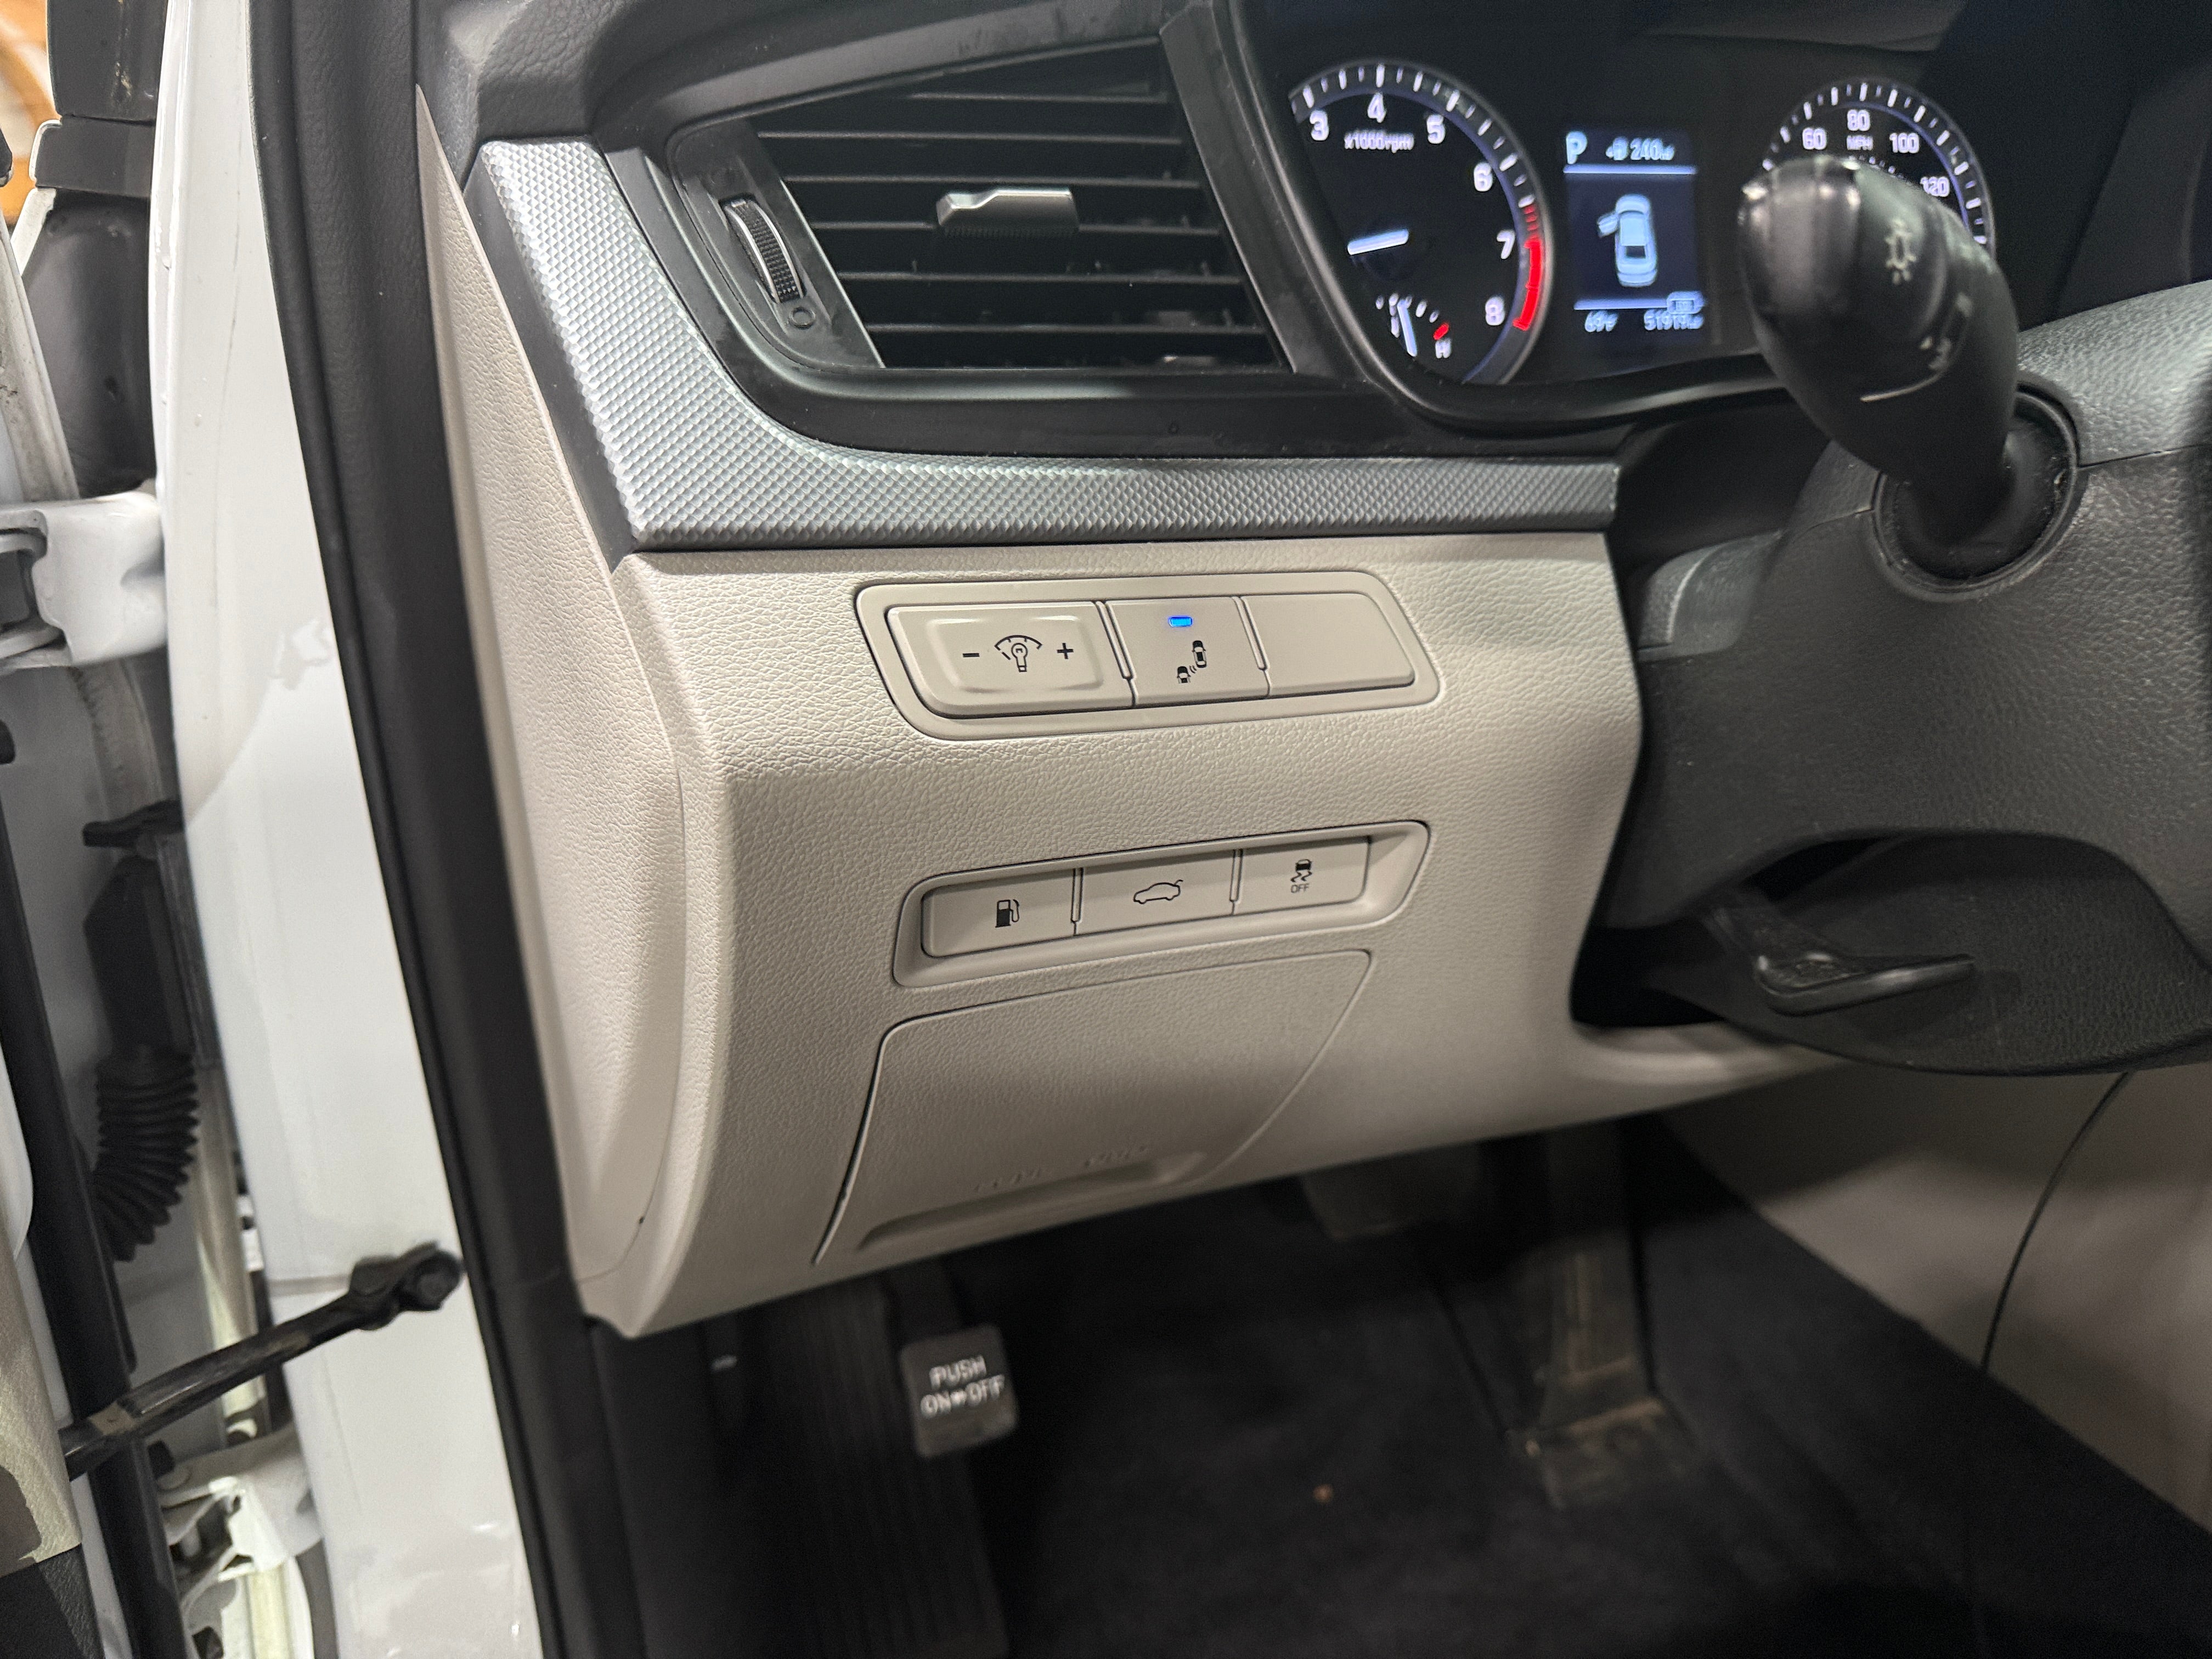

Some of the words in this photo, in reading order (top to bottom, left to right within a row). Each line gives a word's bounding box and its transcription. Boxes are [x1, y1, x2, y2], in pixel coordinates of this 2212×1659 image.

[1367, 92, 1386, 122] 4
[1847, 110, 1871, 131] 80
[1310, 110, 1329, 141] 3
[1426, 114, 1445, 144] 5
[1802, 127, 1827, 150] 60
[1566, 131, 1588, 164] P
[1847, 135, 1874, 150] MPH
[1889, 133, 1920, 153] 100
[1474, 163, 1493, 191] 6
[1920, 176, 1950, 197] 120
[1497, 229, 1515, 259] 7
[1485, 296, 1505, 326] 8
[1435, 338, 1452, 359] H
[1290, 883, 1310, 893] OFF
[929, 1355, 987, 1390] PUSH
[965, 1374, 1005, 1406] OFF
